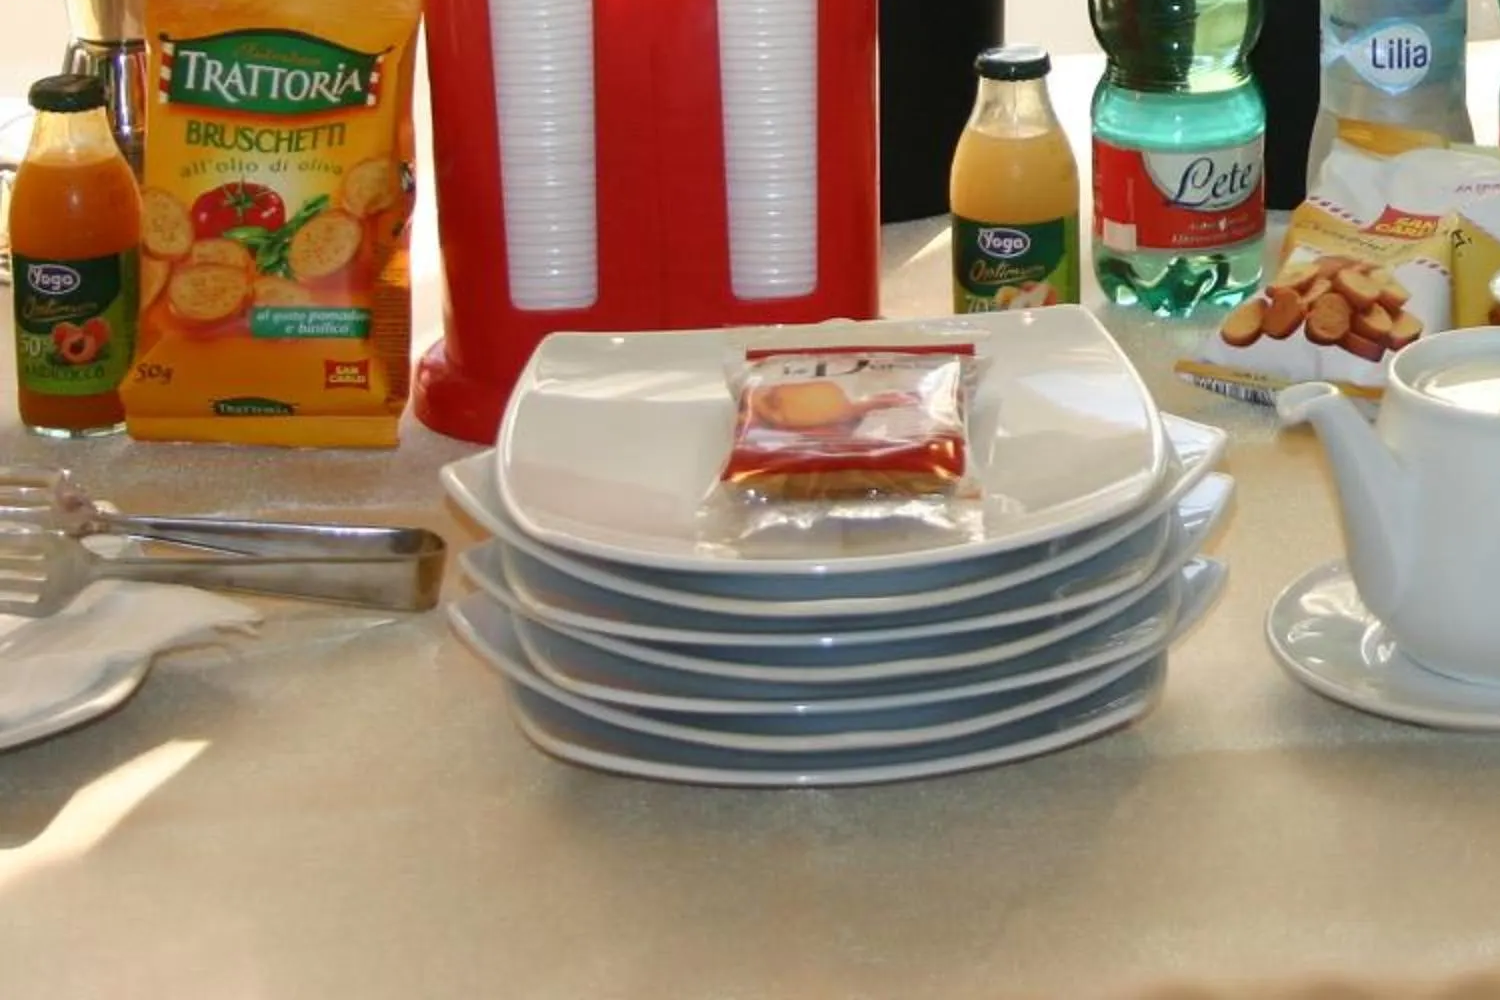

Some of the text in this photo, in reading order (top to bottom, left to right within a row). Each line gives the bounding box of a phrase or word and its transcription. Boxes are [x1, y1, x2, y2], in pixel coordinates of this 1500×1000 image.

[1371, 38, 1429, 70] Lilia
[185, 119, 347, 154] BRUSCHETTI
[269, 157, 288, 173] di
[297, 158, 344, 176] oliva
[1167, 156, 1253, 208] Lete
[982, 230, 1025, 254] Yoga
[32, 265, 74, 291] Yoga
